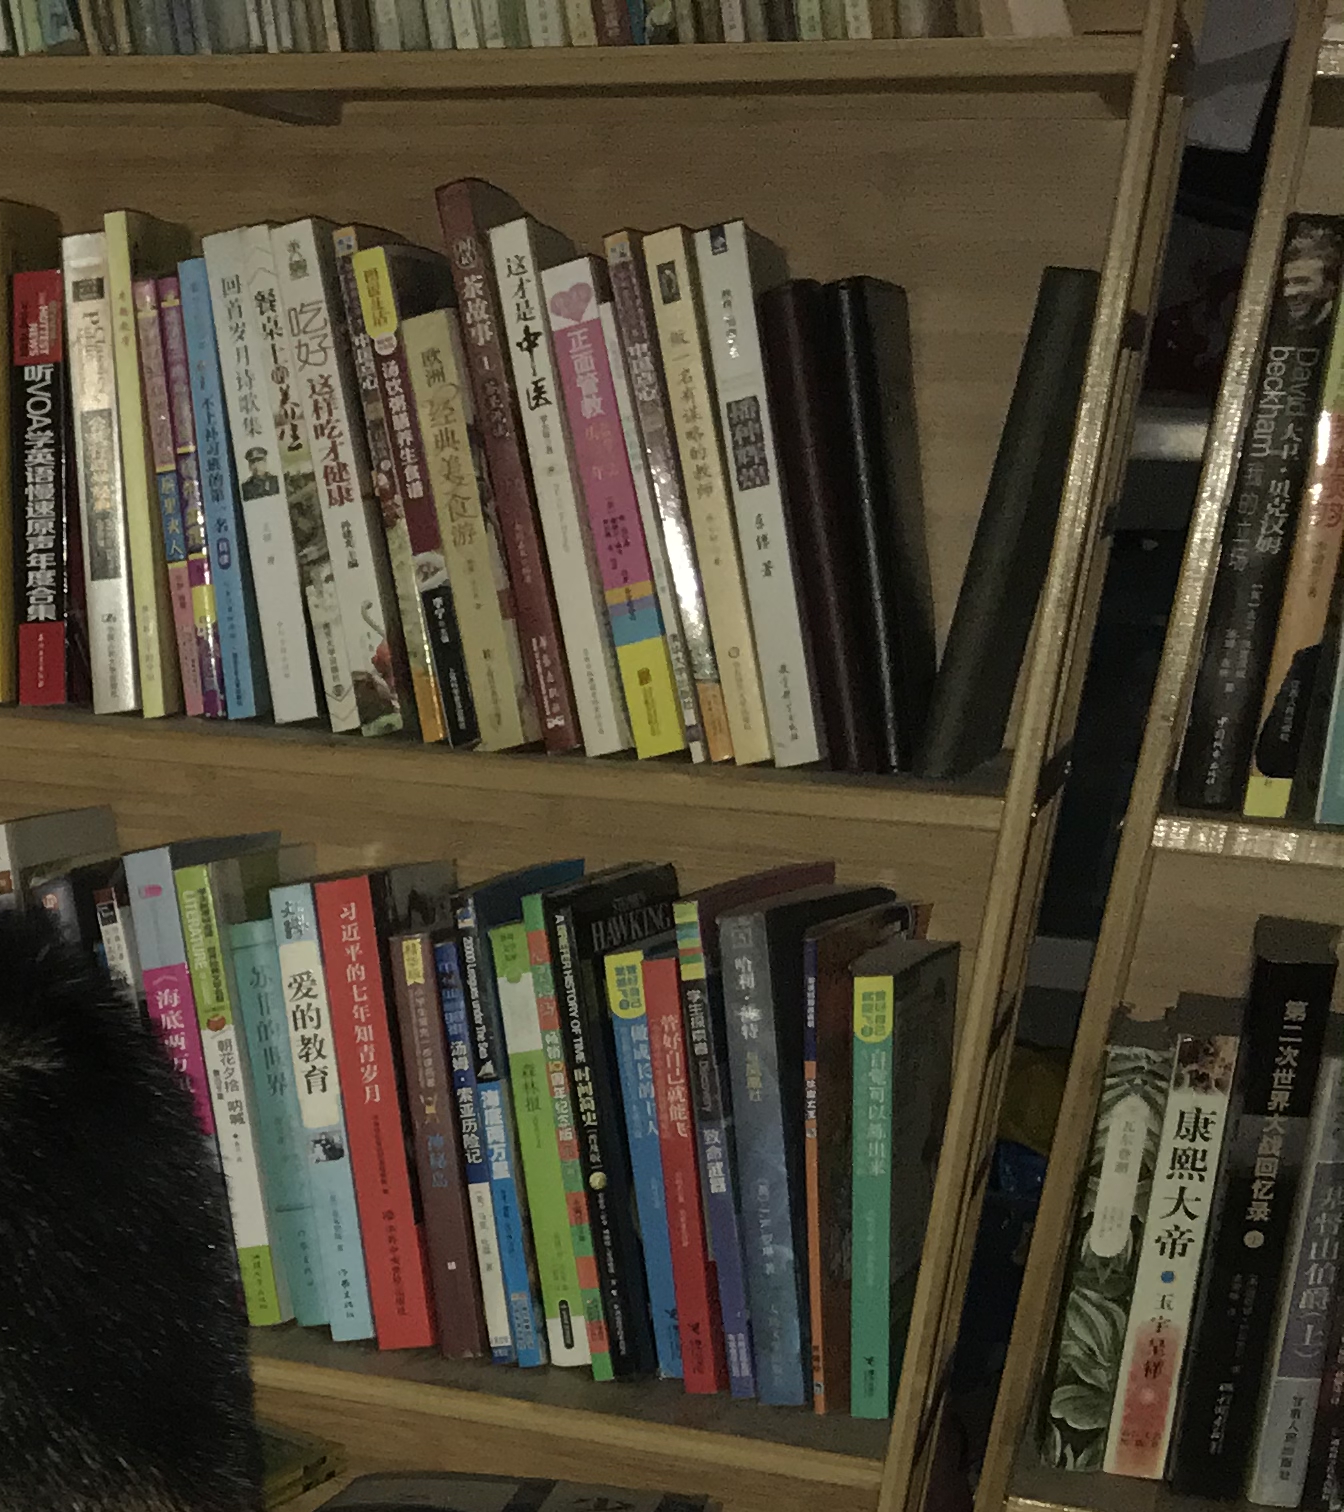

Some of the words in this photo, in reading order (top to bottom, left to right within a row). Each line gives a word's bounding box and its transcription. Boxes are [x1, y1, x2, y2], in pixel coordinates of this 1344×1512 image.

[288, 300, 331, 371] 吃好
[504, 254, 553, 412] 这才是中医
[566, 327, 607, 420] 正面管教
[1252, 346, 1295, 458] beckham
[1285, 347, 1321, 420] David
[308, 373, 355, 509] 这样吃才健康
[591, 902, 672, 951] HAWKING
[287, 970, 331, 1095] 爱的教育
[339, 902, 382, 1105] 习近平的七年知青岁月
[734, 955, 763, 1040] 哈利·波特
[216, 1038, 240, 1093] 朝花夕拾
[450, 1041, 484, 1165] 汤姆·索亚历险记
[521, 1064, 542, 1111] 森林报
[574, 1066, 599, 1127] 时间简史
[1245, 999, 1309, 1223] 第二次世界大战回忆录
[226, 1098, 246, 1126] 呐喊
[479, 1088, 511, 1180] 海底两万里
[1153, 1106, 1218, 1260] 康熙大帝
